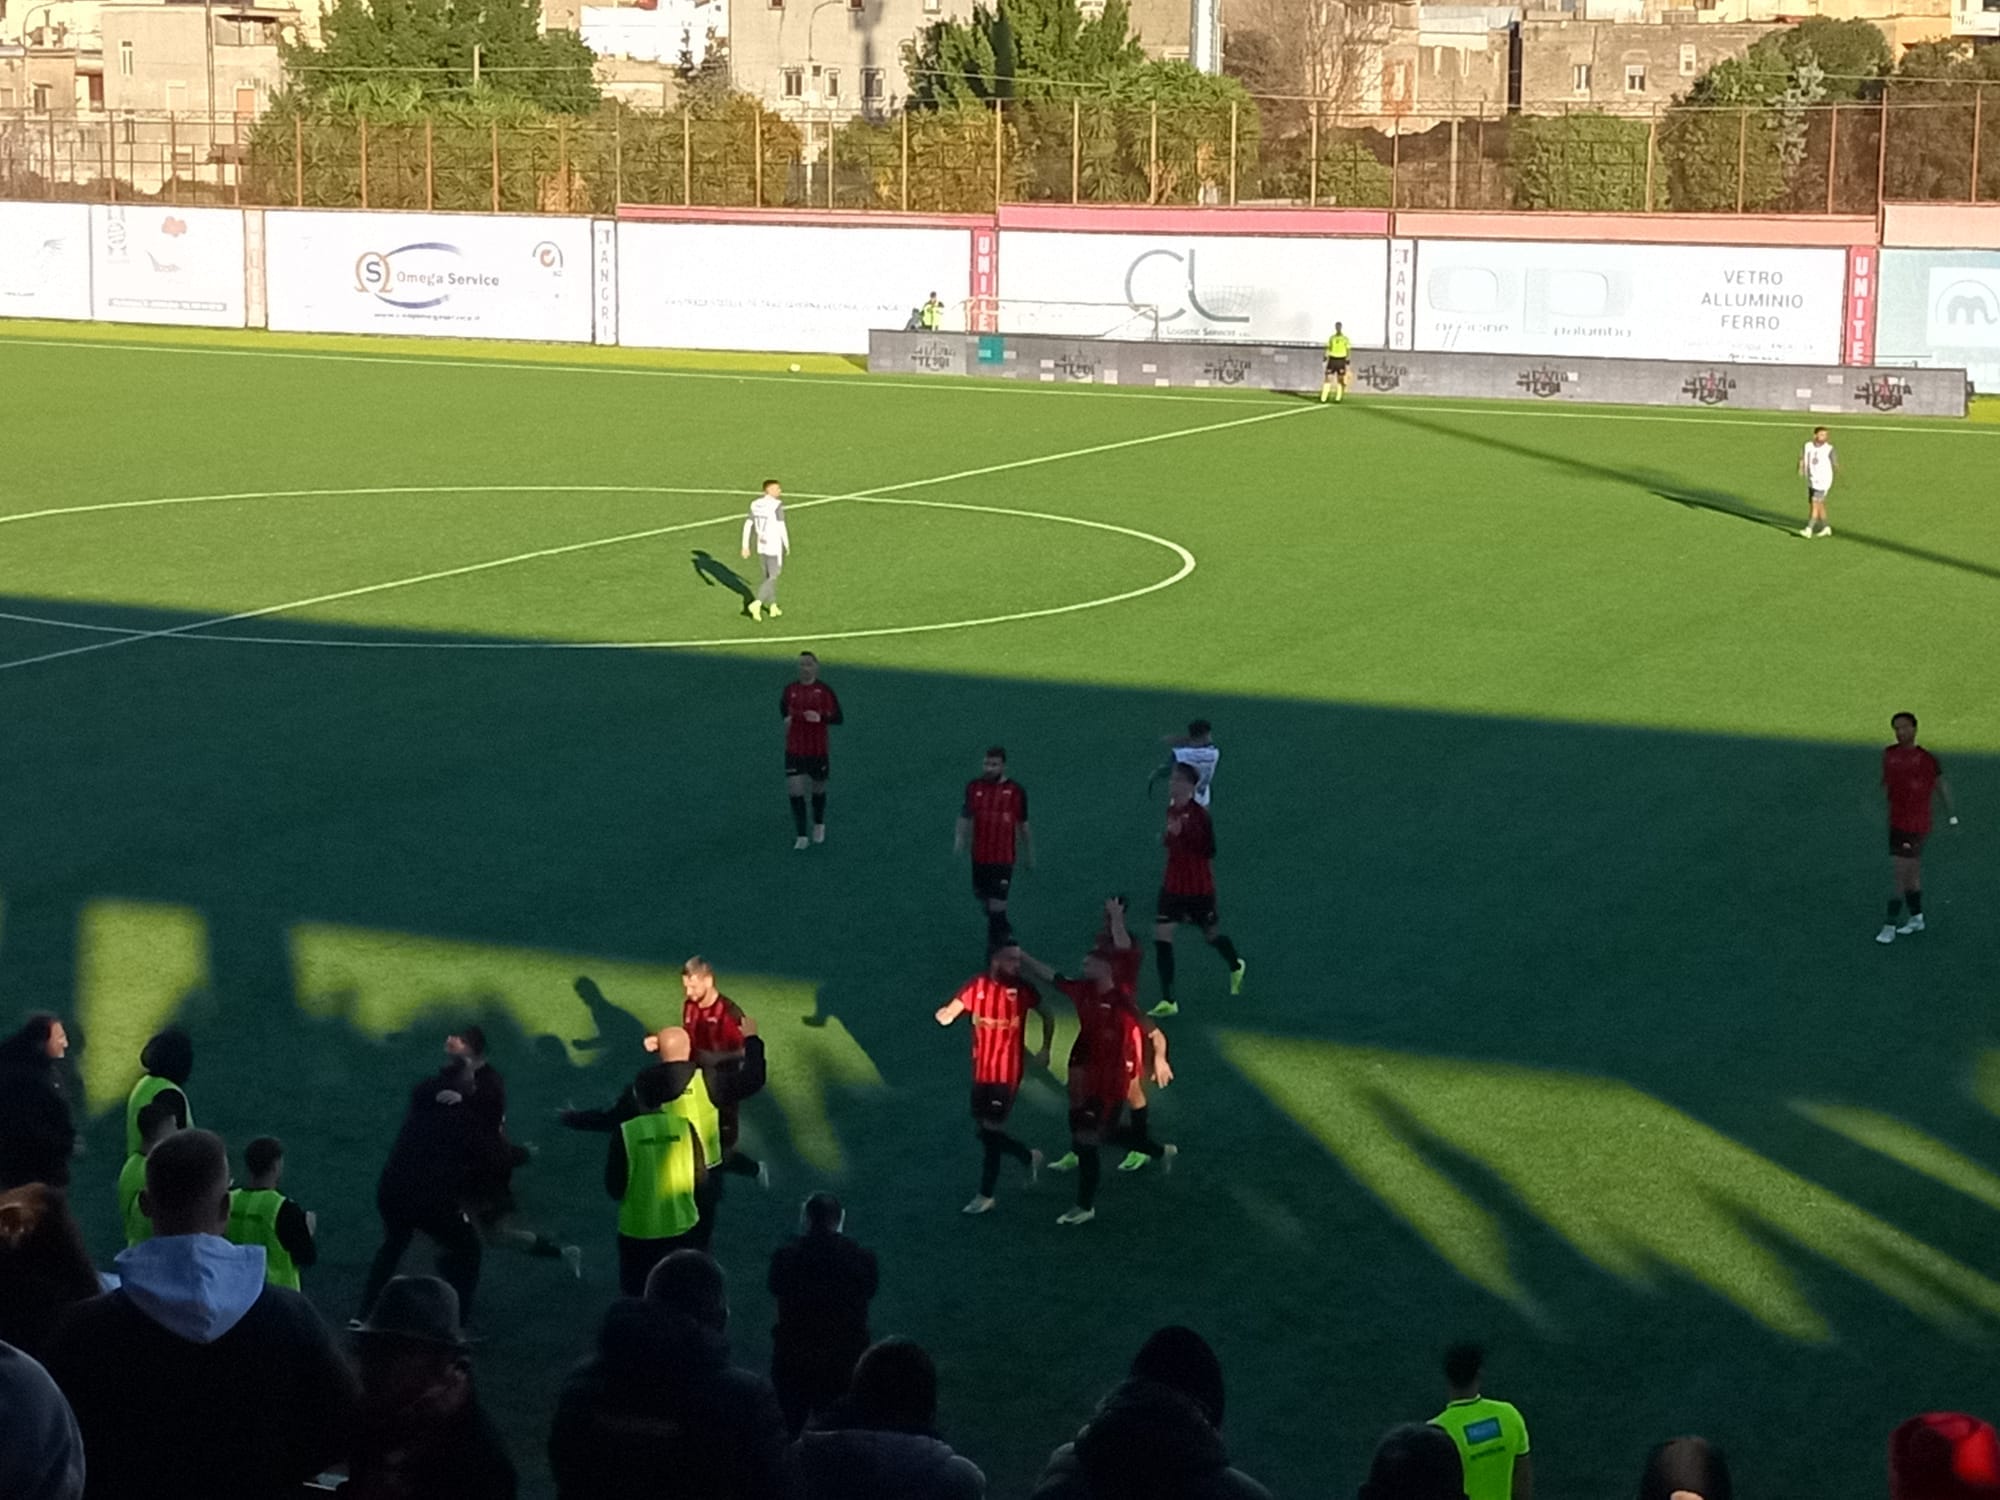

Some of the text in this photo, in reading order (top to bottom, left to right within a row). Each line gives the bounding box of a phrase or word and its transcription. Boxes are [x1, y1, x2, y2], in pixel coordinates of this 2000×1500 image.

[397, 271, 500, 287] Omega Service
[1724, 269, 1784, 285] VETRO
[1701, 291, 1804, 309] ALLUMINIO
[1853, 257, 1869, 365] UNITE
[1721, 315, 1780, 330] FERRO
